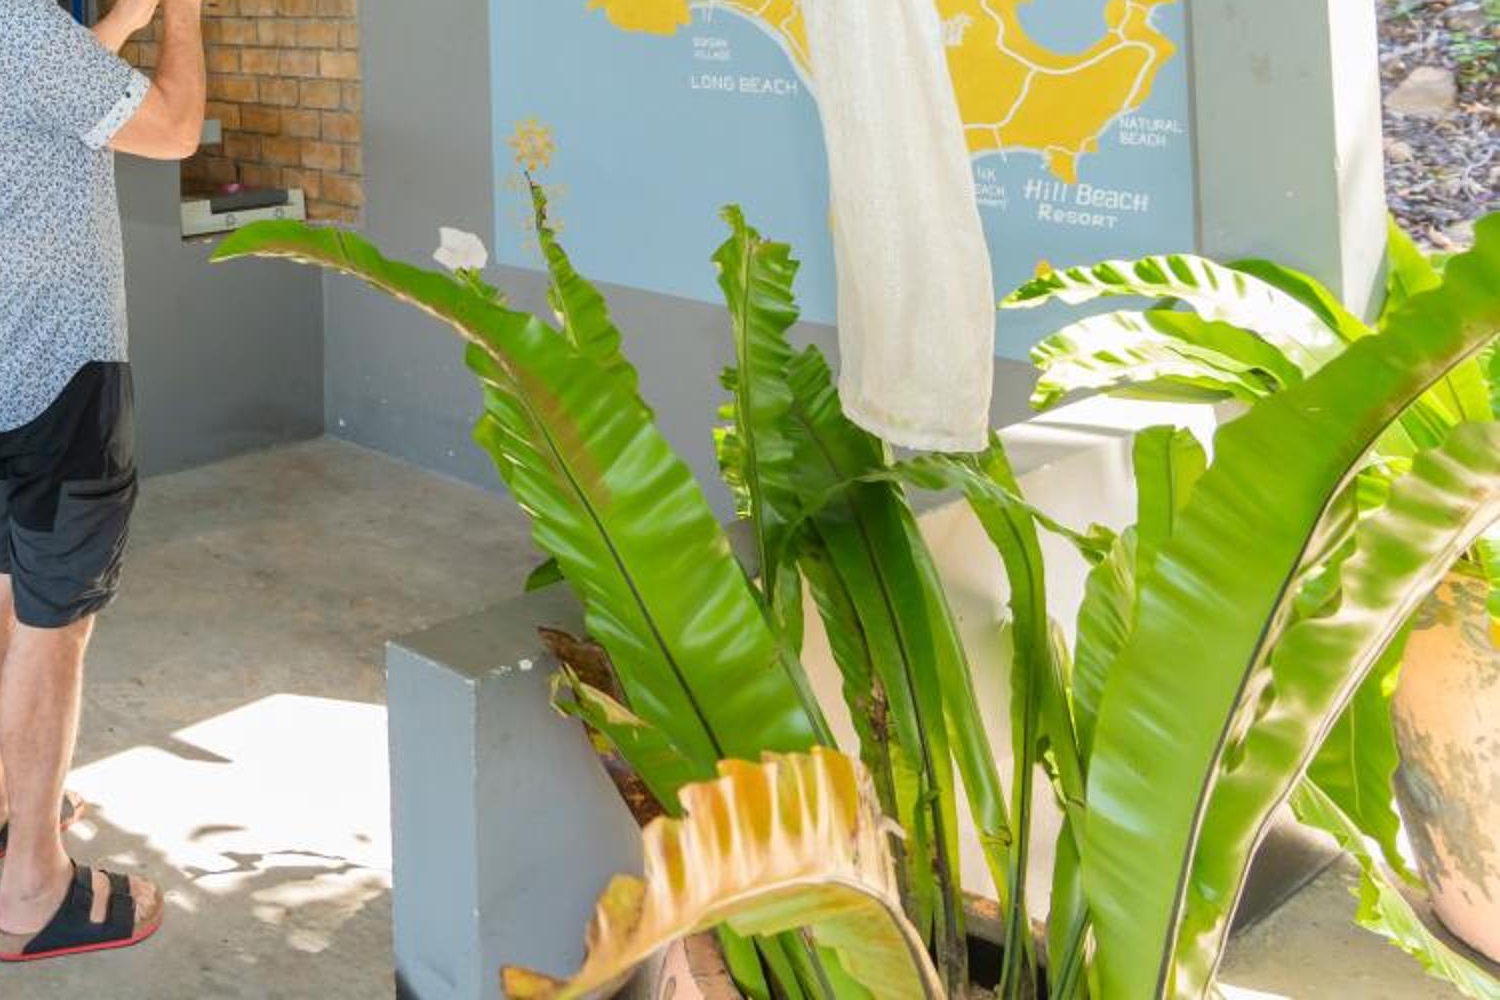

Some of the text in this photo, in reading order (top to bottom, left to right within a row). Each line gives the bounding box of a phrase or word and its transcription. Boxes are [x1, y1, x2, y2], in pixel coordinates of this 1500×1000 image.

[691, 74, 799, 97] LONG BEACH
[1119, 116, 1186, 134] NATURAL
[1119, 131, 1167, 147] BEACH
[974, 184, 1005, 199] EACH
[1024, 177, 1069, 203] Hill
